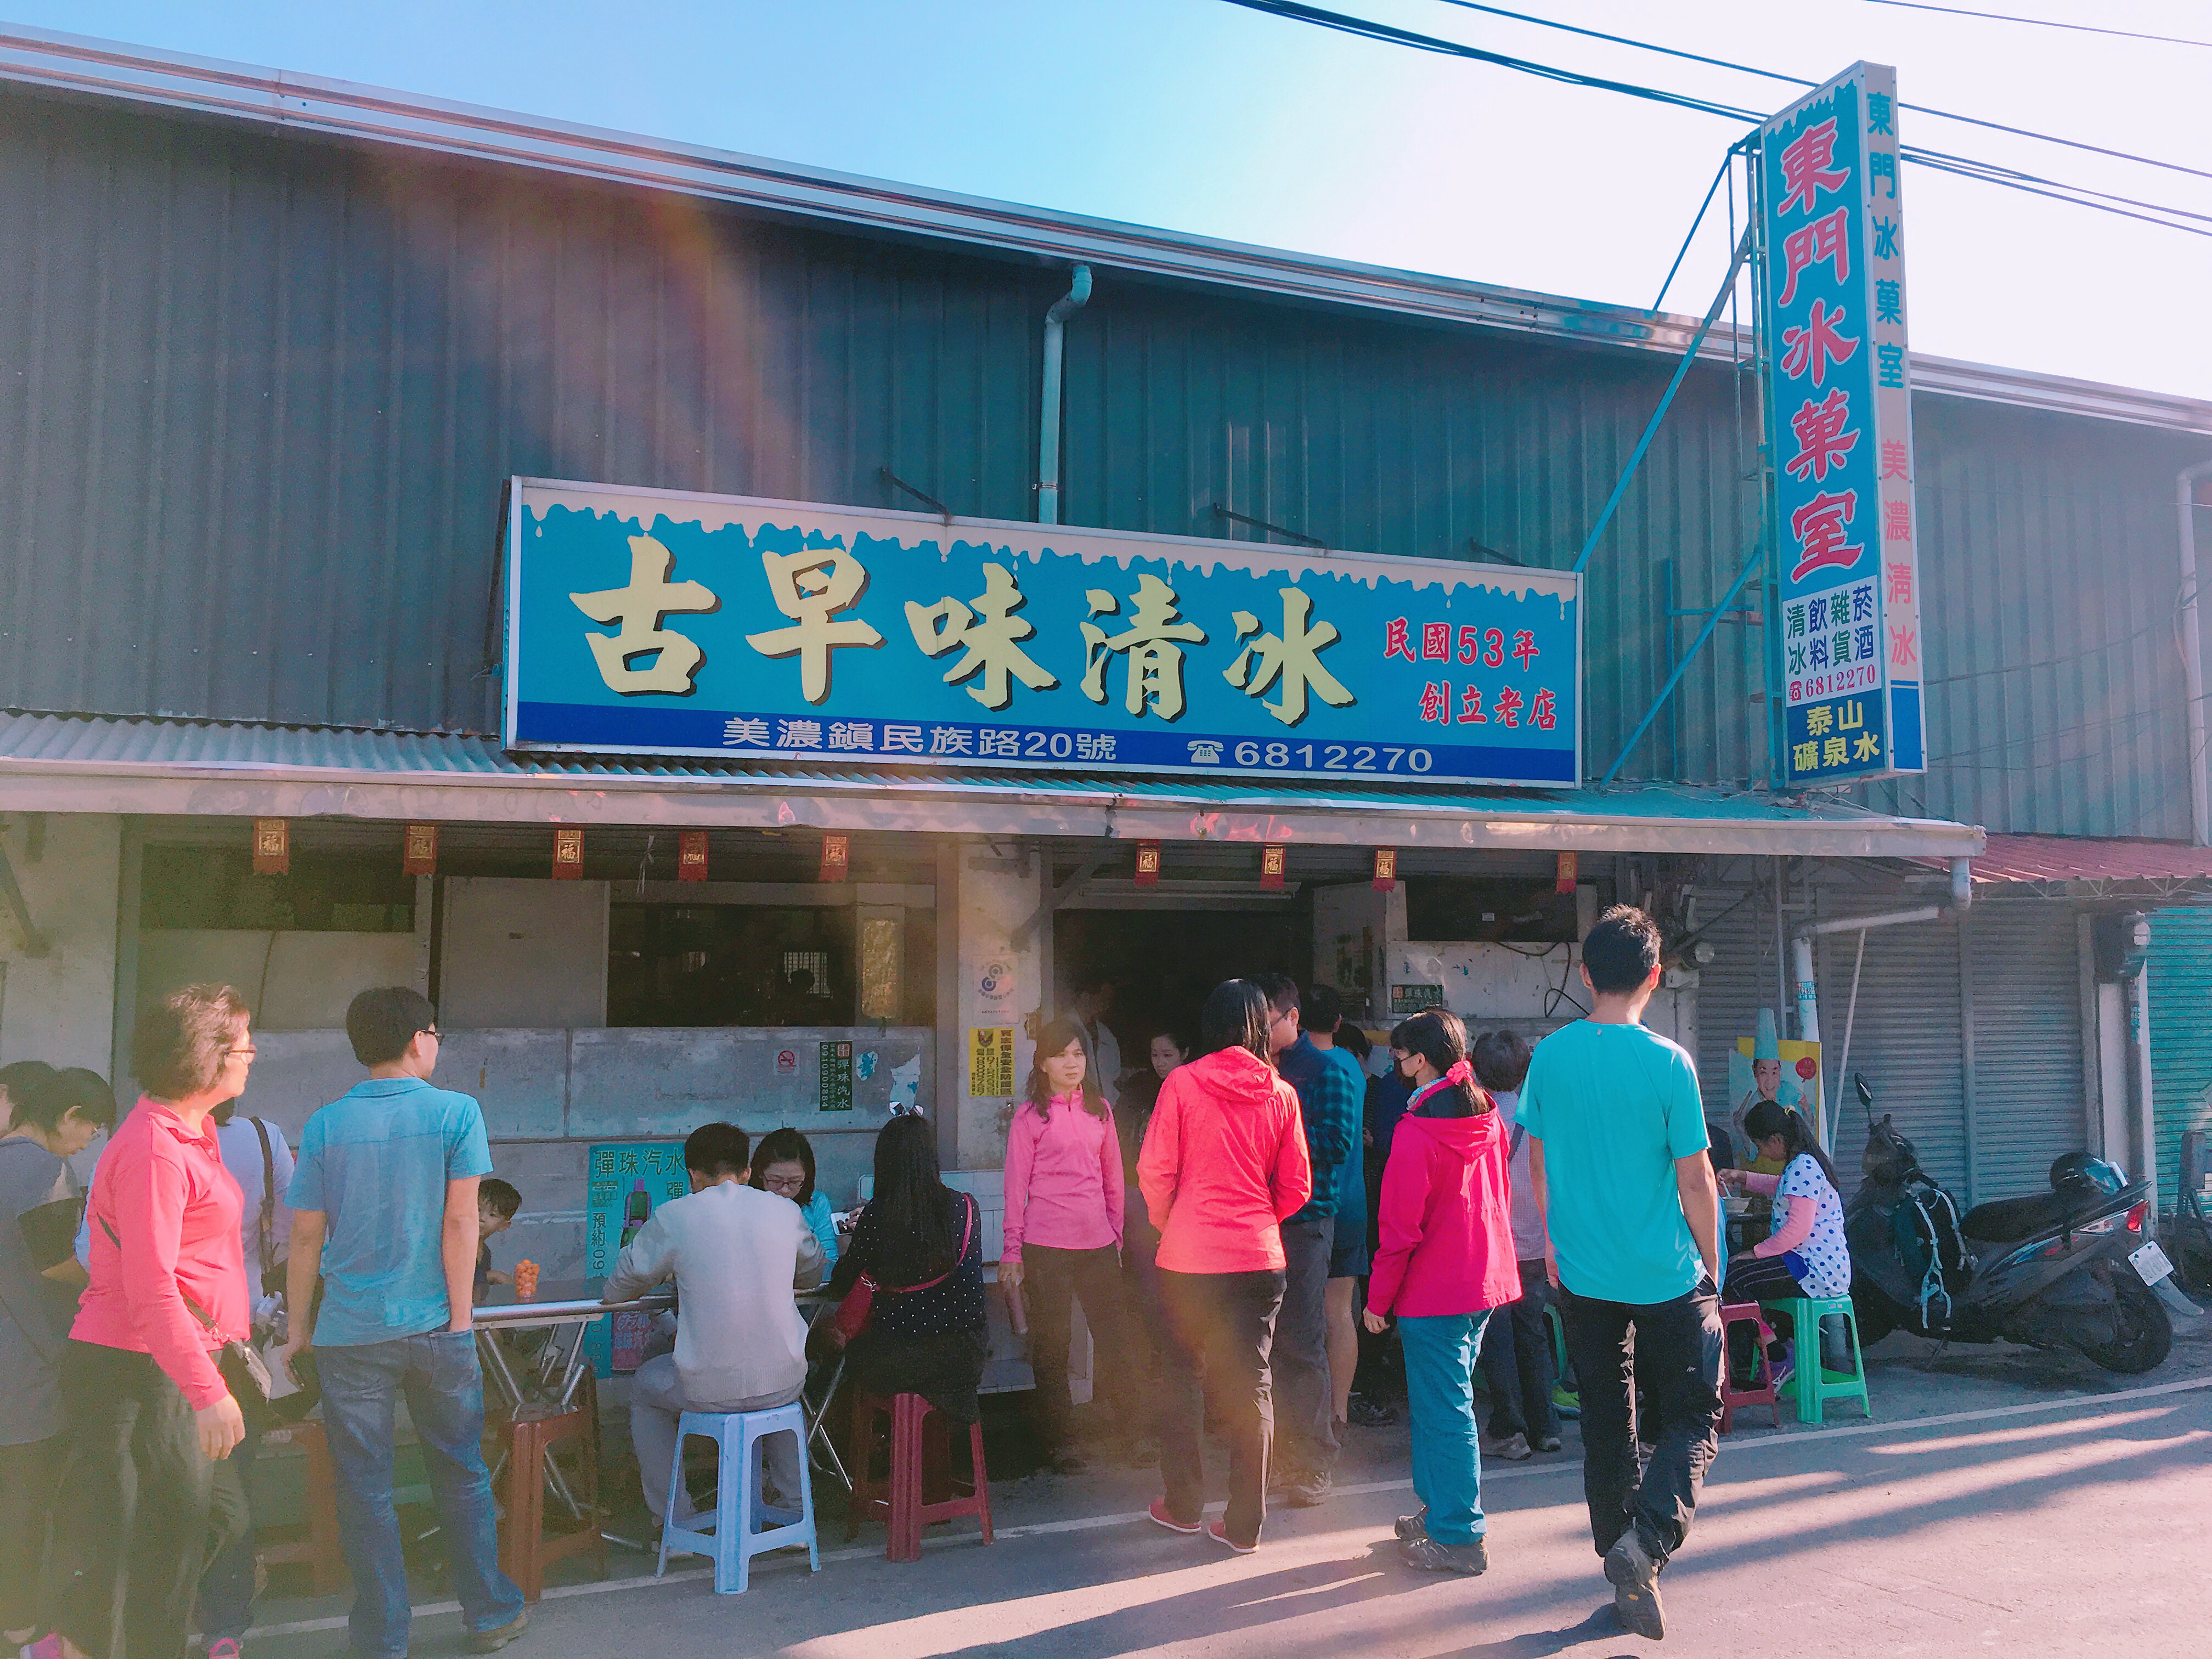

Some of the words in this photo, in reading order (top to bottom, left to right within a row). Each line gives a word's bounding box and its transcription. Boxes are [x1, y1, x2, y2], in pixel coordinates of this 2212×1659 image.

[1867, 92, 1903, 388] 東門冰菓室
[1778, 116, 1865, 585] 東門冰菓室
[1882, 439, 1916, 666] 美濃清冰
[569, 533, 1357, 727] 古早味清冰
[1384, 616, 1540, 672] 民國53年
[1787, 603, 1807, 675] 清冰
[1808, 597, 1829, 672] 飲料
[1830, 589, 1852, 667] 雜貨
[1853, 584, 1874, 661] 菸酒
[1419, 680, 1557, 730] 創立老店
[1805, 664, 1875, 697] 6812270
[1807, 699, 1864, 736] 泰山
[1234, 741, 1433, 771] 6812270
[1793, 731, 1880, 771] 礦泉水
[837, 1059, 850, 1108] 彈珠汽水
[594, 1148, 686, 1178] 彈珠汽水
